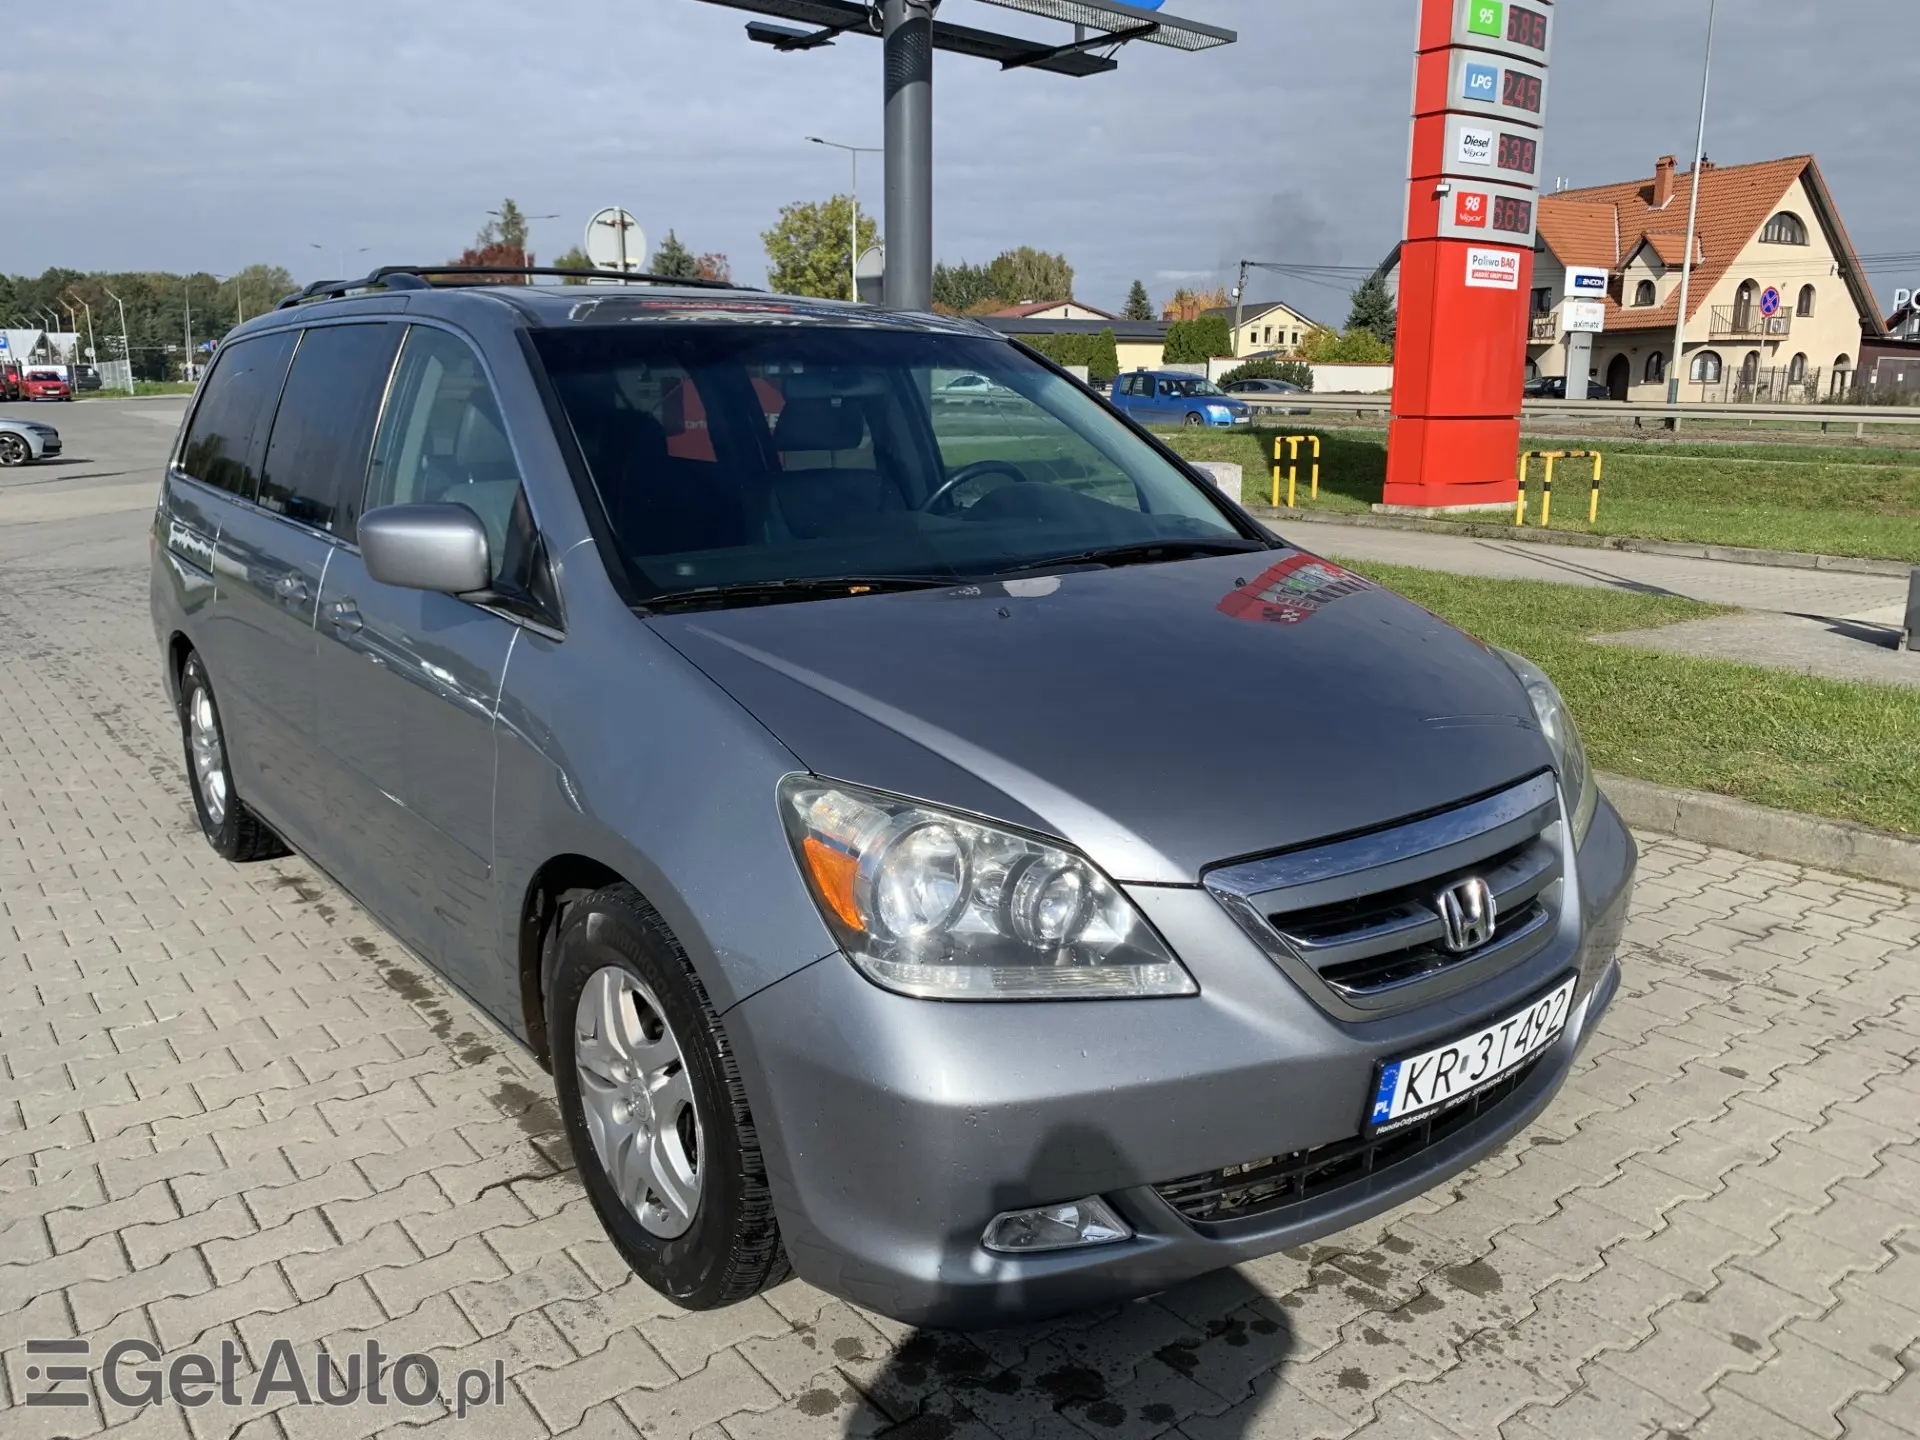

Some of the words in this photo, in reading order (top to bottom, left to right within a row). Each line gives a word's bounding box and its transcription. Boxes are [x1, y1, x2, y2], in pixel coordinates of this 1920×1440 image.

[1479, 8, 1494, 25] 95
[1470, 73, 1493, 90] LPG
[1464, 134, 1491, 148] Diesel
[1465, 196, 1481, 212] 98
[1402, 1047, 1460, 1111] KR
[1470, 988, 1567, 1081] 3T492
[1373, 1100, 1390, 1117] PL
